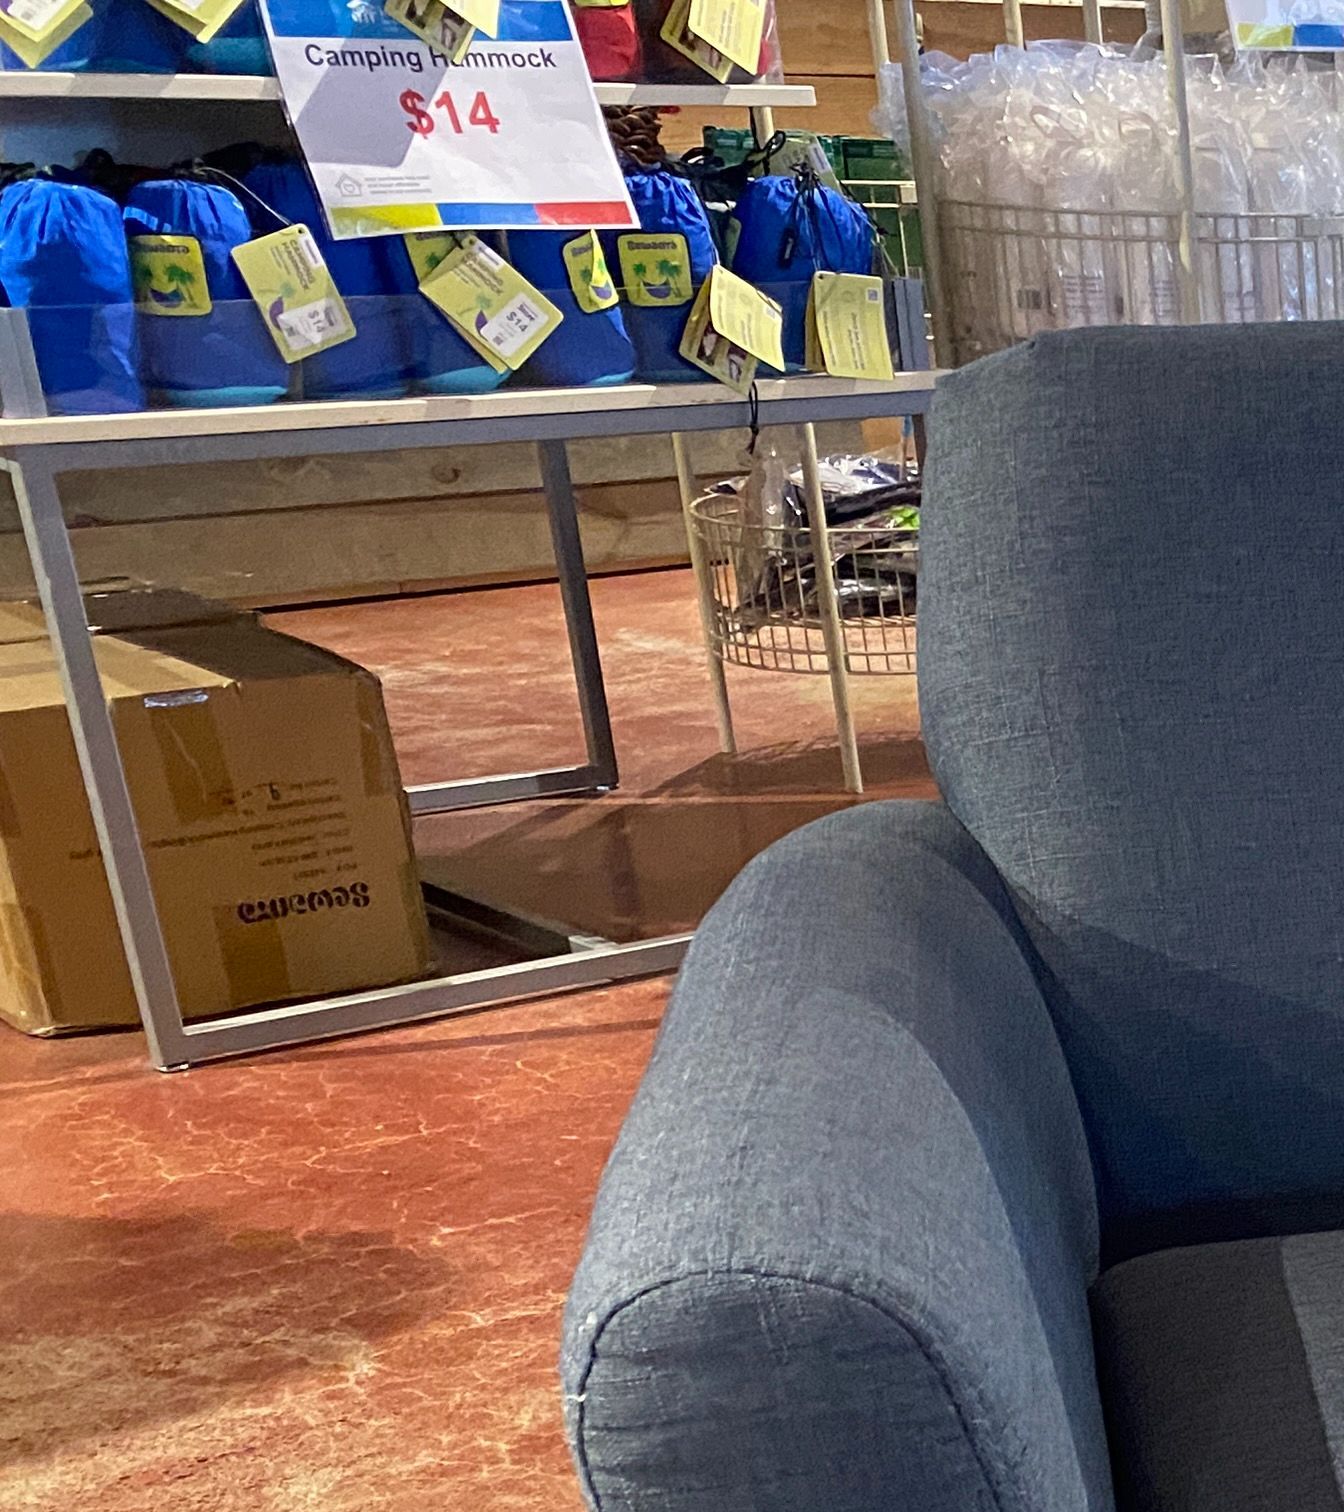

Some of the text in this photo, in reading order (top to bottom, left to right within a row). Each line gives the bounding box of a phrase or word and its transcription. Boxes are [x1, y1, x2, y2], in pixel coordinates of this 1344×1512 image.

[304, 43, 557, 73] Camping Hmmock
[399, 88, 500, 139] $14
[506, 311, 529, 332] $14
